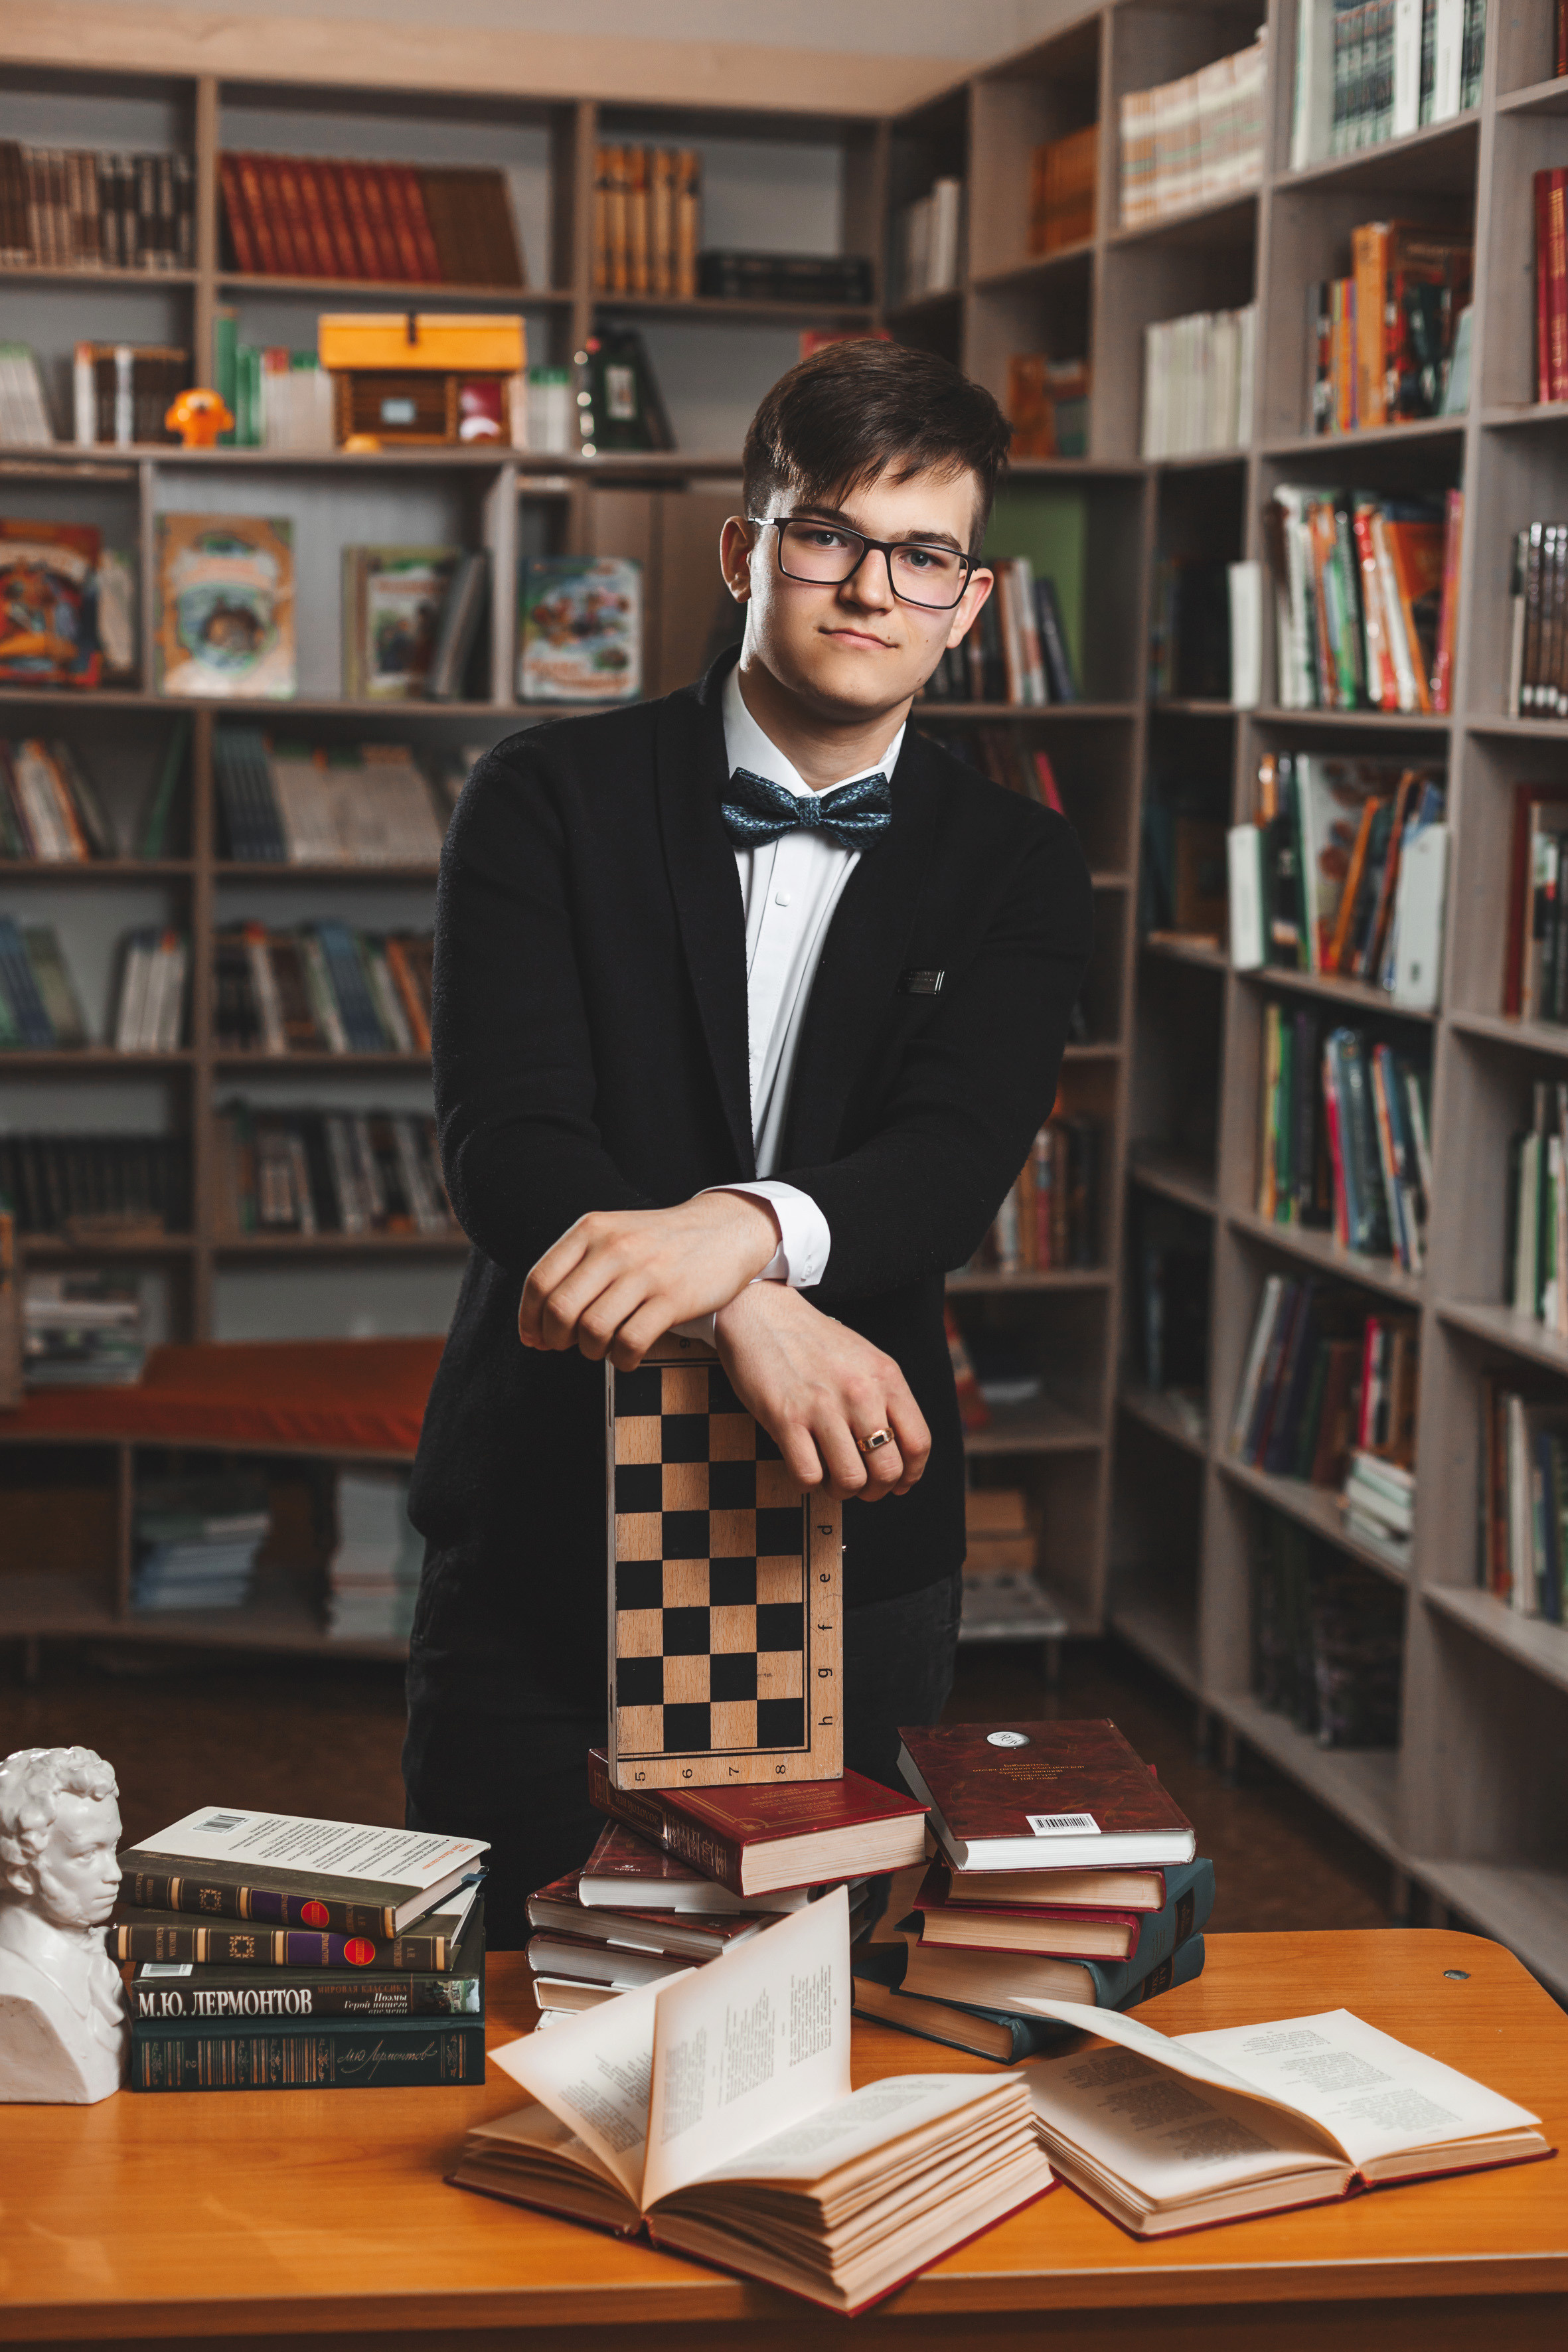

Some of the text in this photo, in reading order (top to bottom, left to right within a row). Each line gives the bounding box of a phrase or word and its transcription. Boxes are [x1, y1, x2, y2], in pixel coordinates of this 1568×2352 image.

[817, 1525, 832, 1535] d
[819, 1573, 830, 1583] e
[818, 1668, 832, 1678] g
[818, 1716, 832, 1725] h
[635, 1764, 786, 1782] 5 6 7 8
[317, 1984, 408, 1994] МИРОВАЯ КЛАССИКА
[374, 1992, 407, 2001] Поэмы
[138, 1989, 313, 2017] М.Ю. ЛЕРМОНТОВ
[344, 2000, 370, 2011] Герой
